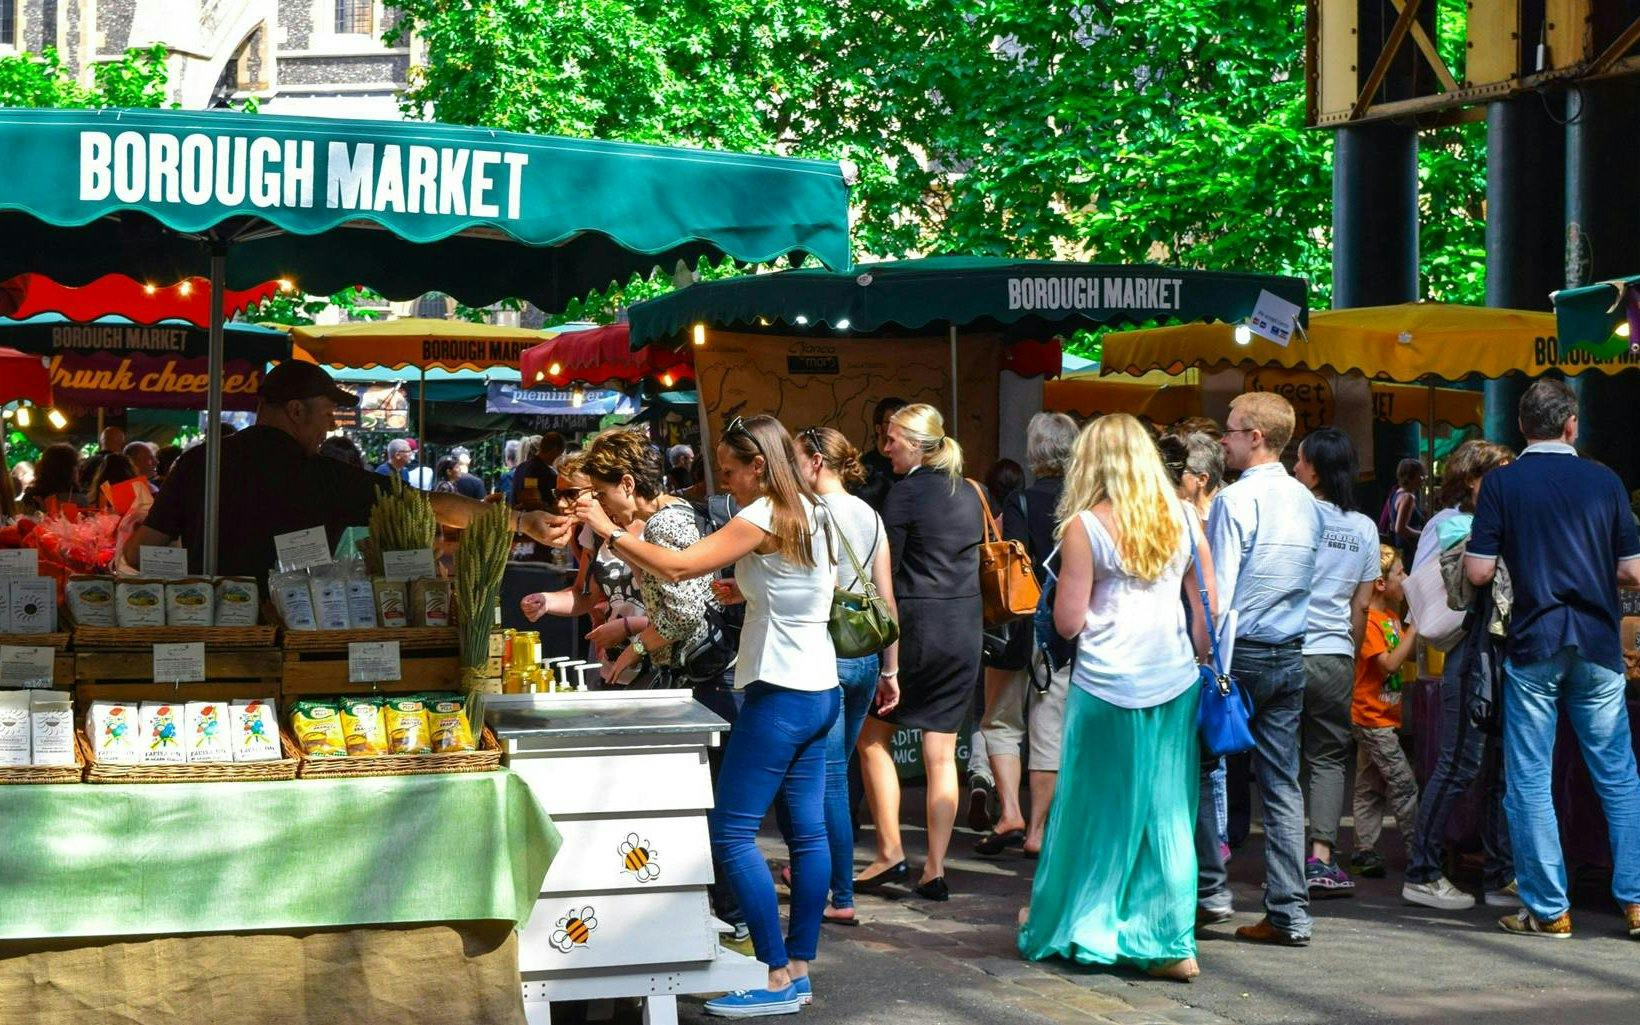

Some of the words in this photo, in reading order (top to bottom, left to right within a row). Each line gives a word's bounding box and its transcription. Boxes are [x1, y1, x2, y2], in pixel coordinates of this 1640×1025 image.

[79, 131, 315, 209] BOROUGH
[327, 140, 530, 220] MARKET
[1007, 277, 1099, 310] BOROUGH
[1103, 278, 1183, 310] MARKET
[52, 327, 123, 349] BOROUGH
[125, 328, 188, 350] MARKET
[422, 340, 487, 360] BOROUGH
[139, 360, 259, 394] cheees
[511, 387, 604, 404] pieminiter
